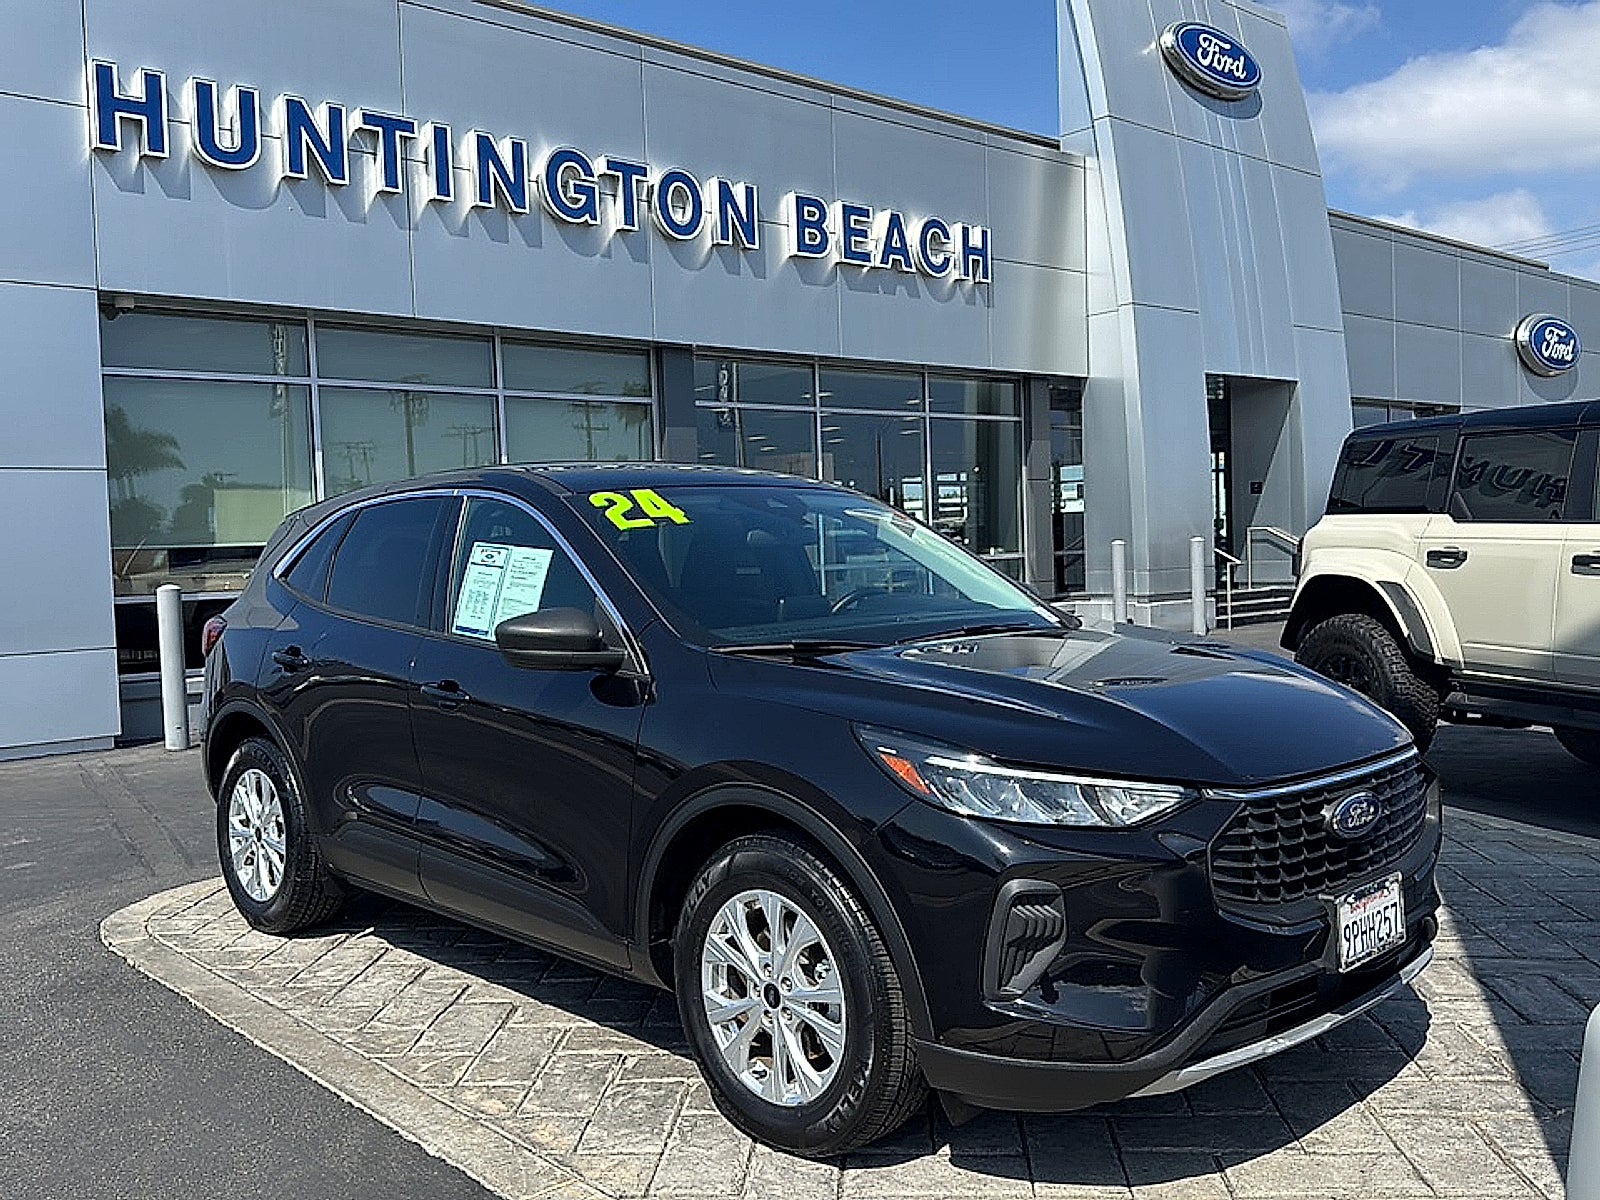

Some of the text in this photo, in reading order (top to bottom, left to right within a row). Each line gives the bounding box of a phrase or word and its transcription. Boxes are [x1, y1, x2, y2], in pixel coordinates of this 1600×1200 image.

[1197, 33, 1247, 79] Ford
[91, 58, 993, 284] HUNTINGTON BEACH
[1542, 326, 1575, 361] Ford
[588, 489, 690, 531] 24
[1348, 801, 1375, 828] Ford
[1343, 901, 1398, 959] 9PHH257
